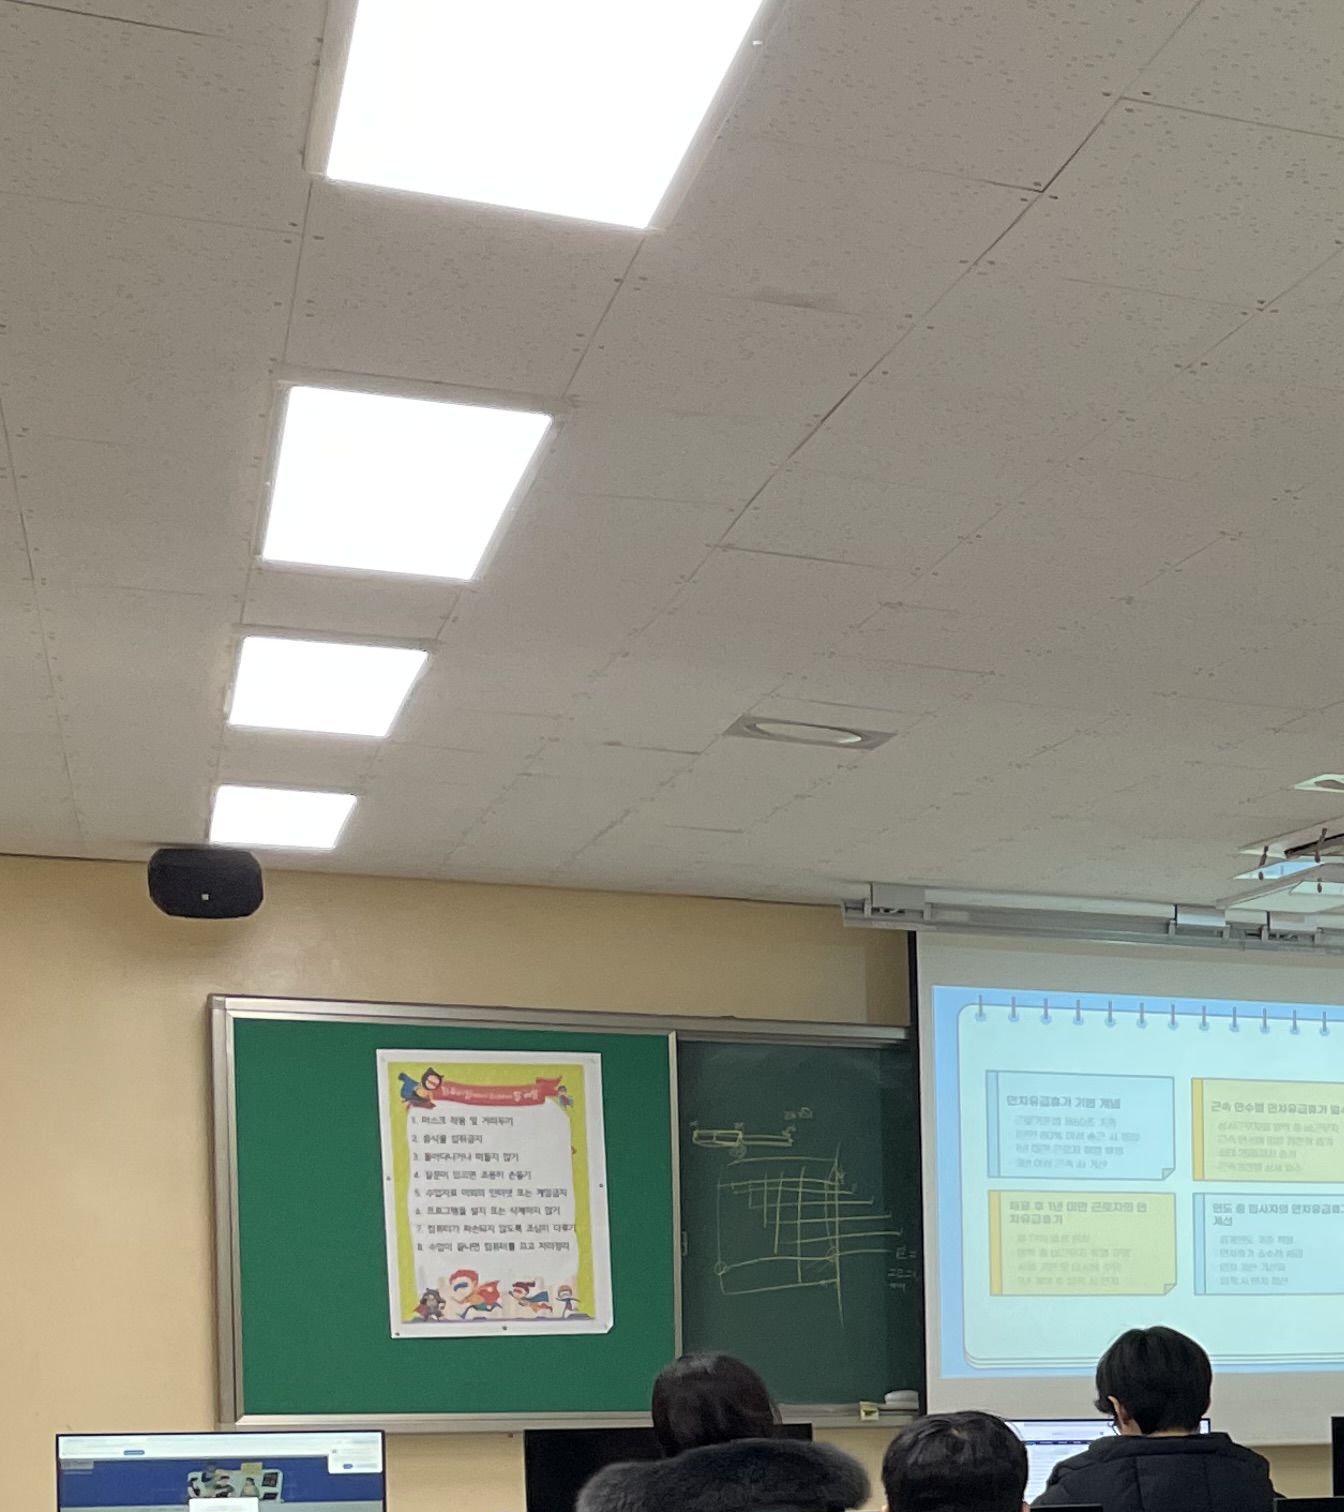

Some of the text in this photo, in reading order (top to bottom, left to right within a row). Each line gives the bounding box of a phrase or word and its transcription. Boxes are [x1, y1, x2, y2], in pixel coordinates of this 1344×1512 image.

[422, 1116, 446, 1125] 마스크
[469, 1116, 478, 1126] 및
[423, 1134, 447, 1144] 음식물
[451, 1134, 483, 1144] 섭취금지
[503, 1152, 519, 1162] 않기
[425, 1170, 449, 1180] 질문이
[452, 1170, 477, 1180] 있으면
[480, 1170, 504, 1180] 조용히
[509, 1170, 532, 1180] 손들기
